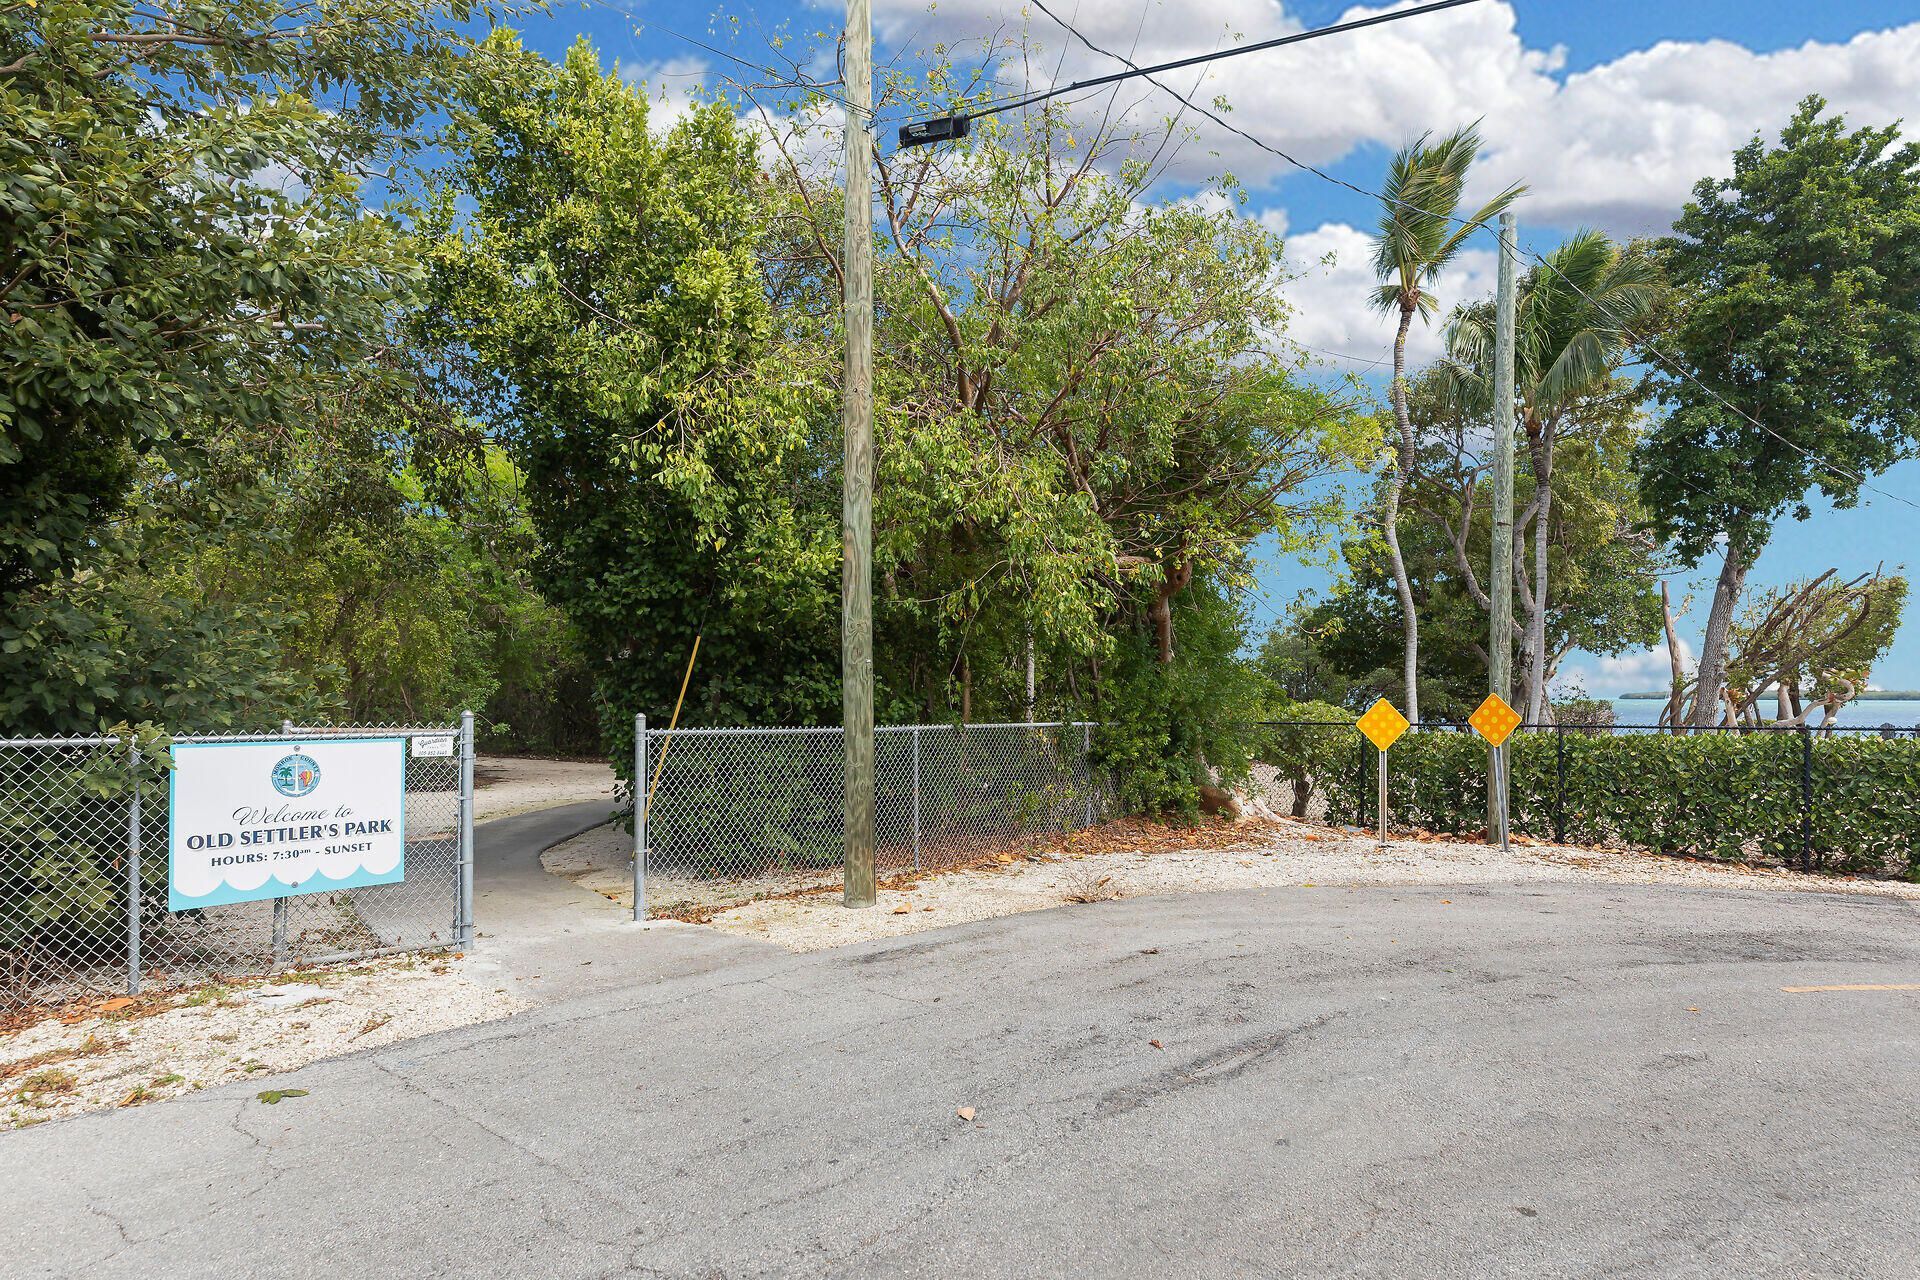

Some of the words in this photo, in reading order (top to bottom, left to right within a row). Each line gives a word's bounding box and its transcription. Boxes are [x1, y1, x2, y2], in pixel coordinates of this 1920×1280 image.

[273, 756, 293, 775] MONROE
[300, 756, 320, 773] COUNTY
[232, 804, 328, 826] Welcome
[336, 804, 354, 817] to
[187, 832, 233, 850] OLD
[240, 824, 337, 845] SETTLER'S
[345, 819, 392, 836] PARK
[211, 853, 268, 867] HOURS:
[273, 848, 311, 861] 7:30am
[324, 842, 373, 855] SUNSET
